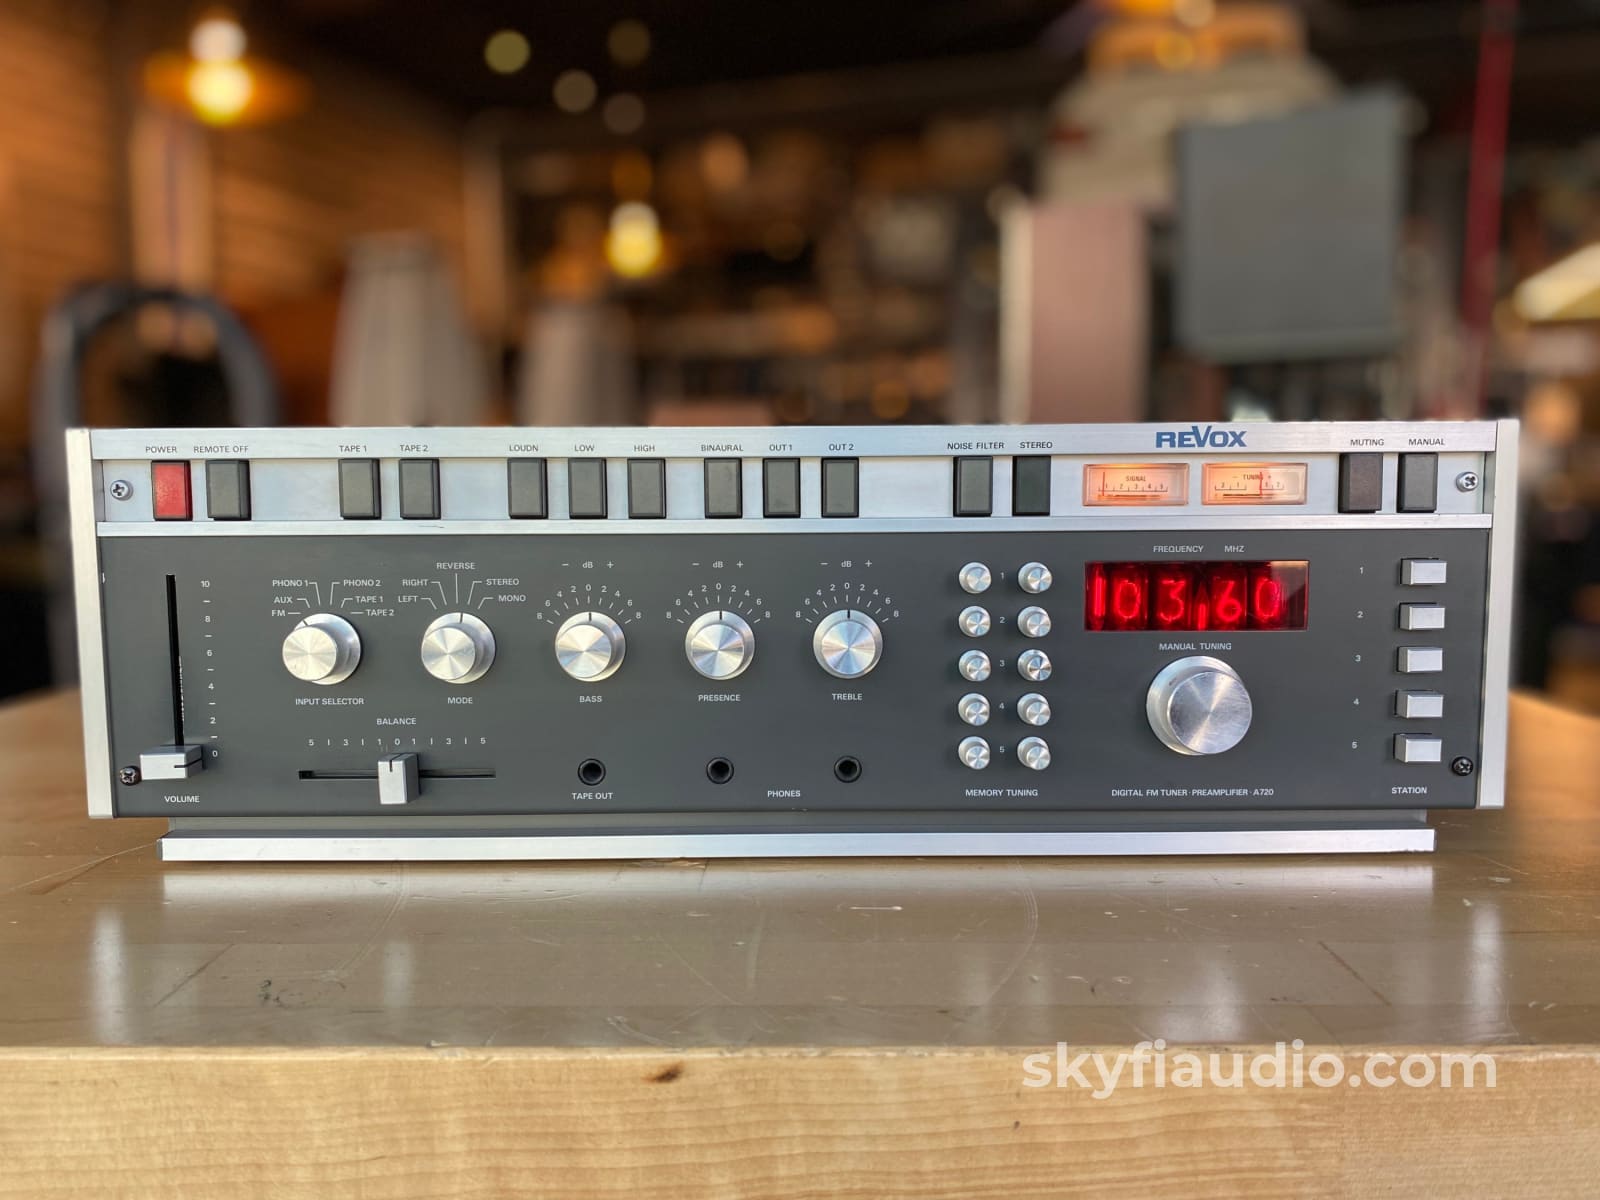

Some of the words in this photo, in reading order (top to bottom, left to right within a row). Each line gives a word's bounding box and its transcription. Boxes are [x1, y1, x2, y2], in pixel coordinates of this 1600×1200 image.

[947, 442, 973, 450] NOISE
[1020, 441, 1052, 449] STEREO
[1409, 438, 1445, 446] MANUAL
